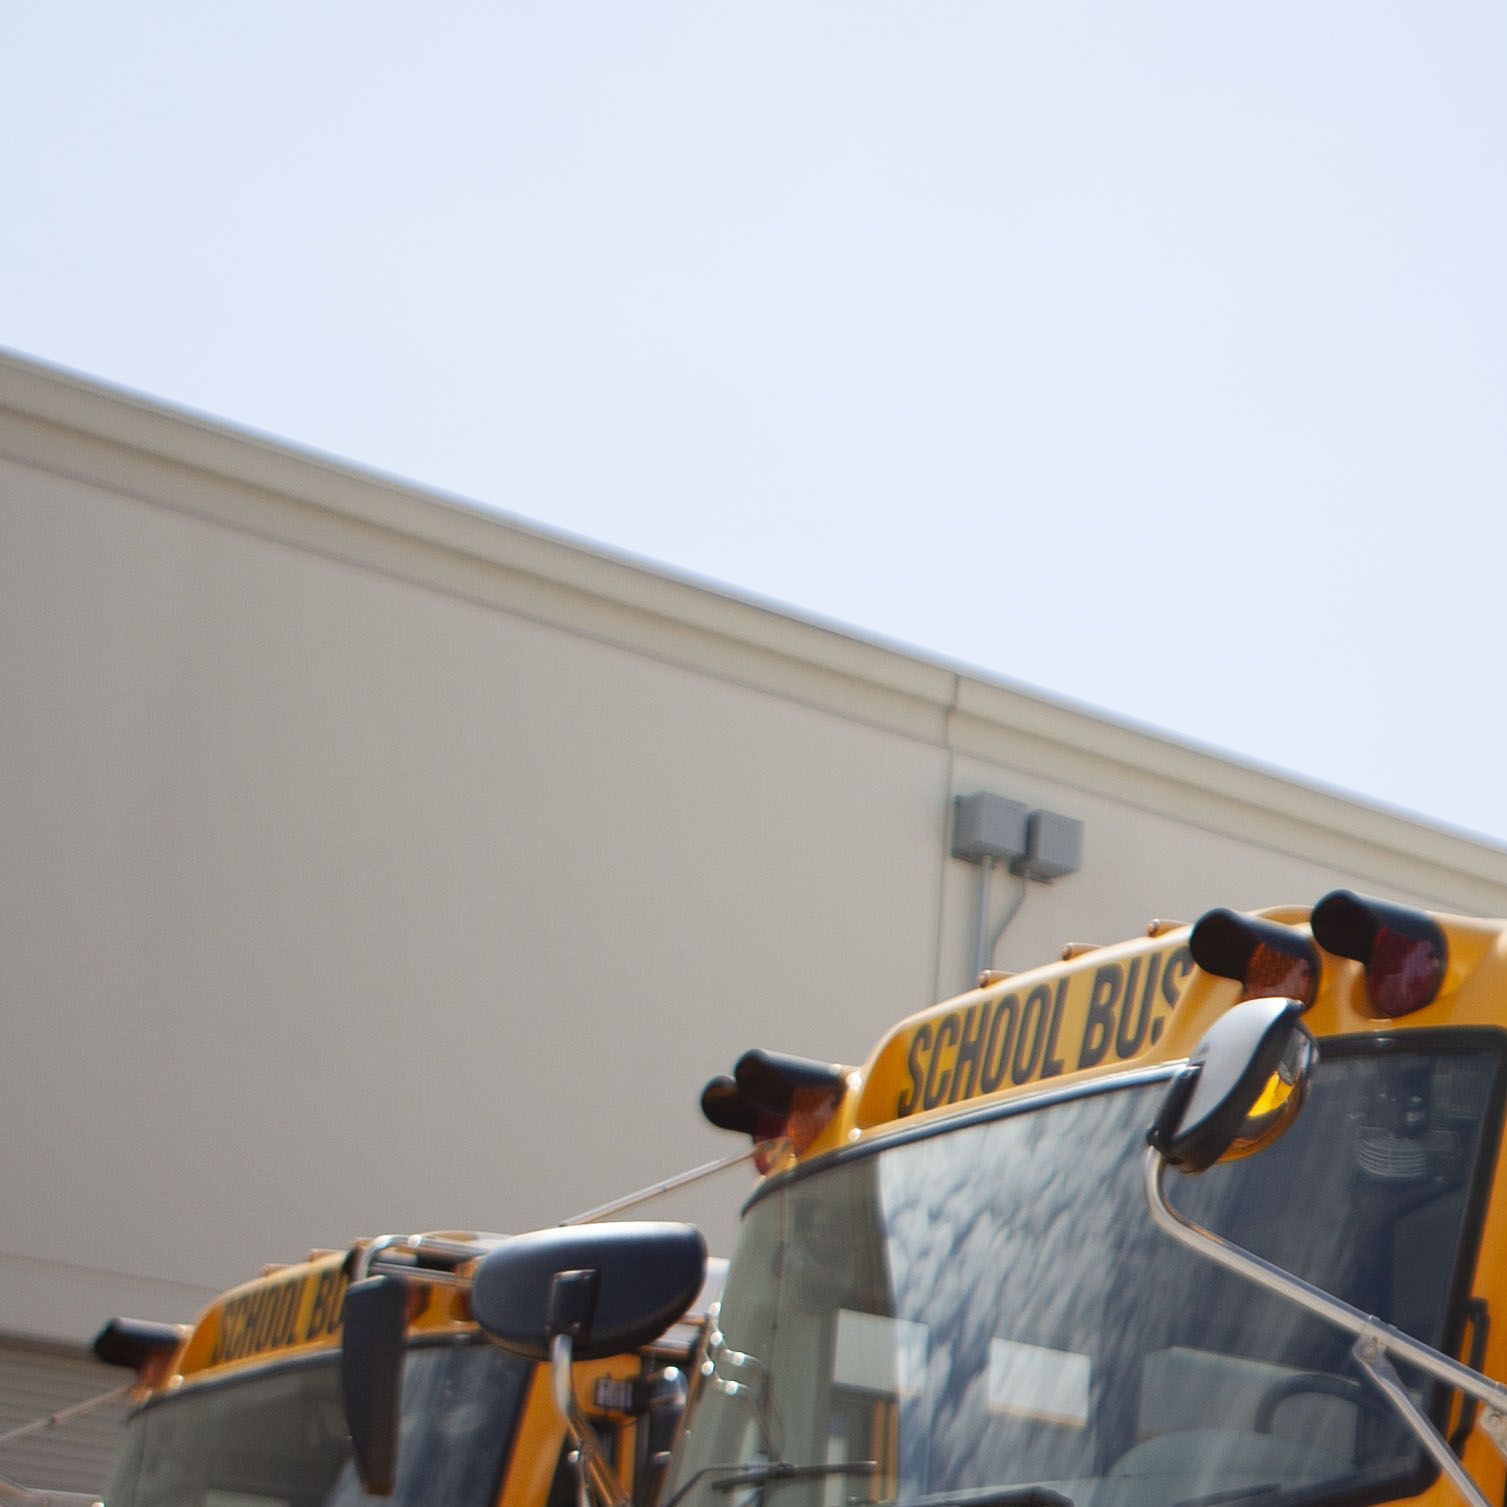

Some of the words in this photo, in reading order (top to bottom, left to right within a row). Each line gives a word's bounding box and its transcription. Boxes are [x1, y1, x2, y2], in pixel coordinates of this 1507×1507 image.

[897, 976, 1072, 1120] SCHOOL
[1076, 945, 1197, 1069] BUS
[305, 1268, 348, 1340] BU
